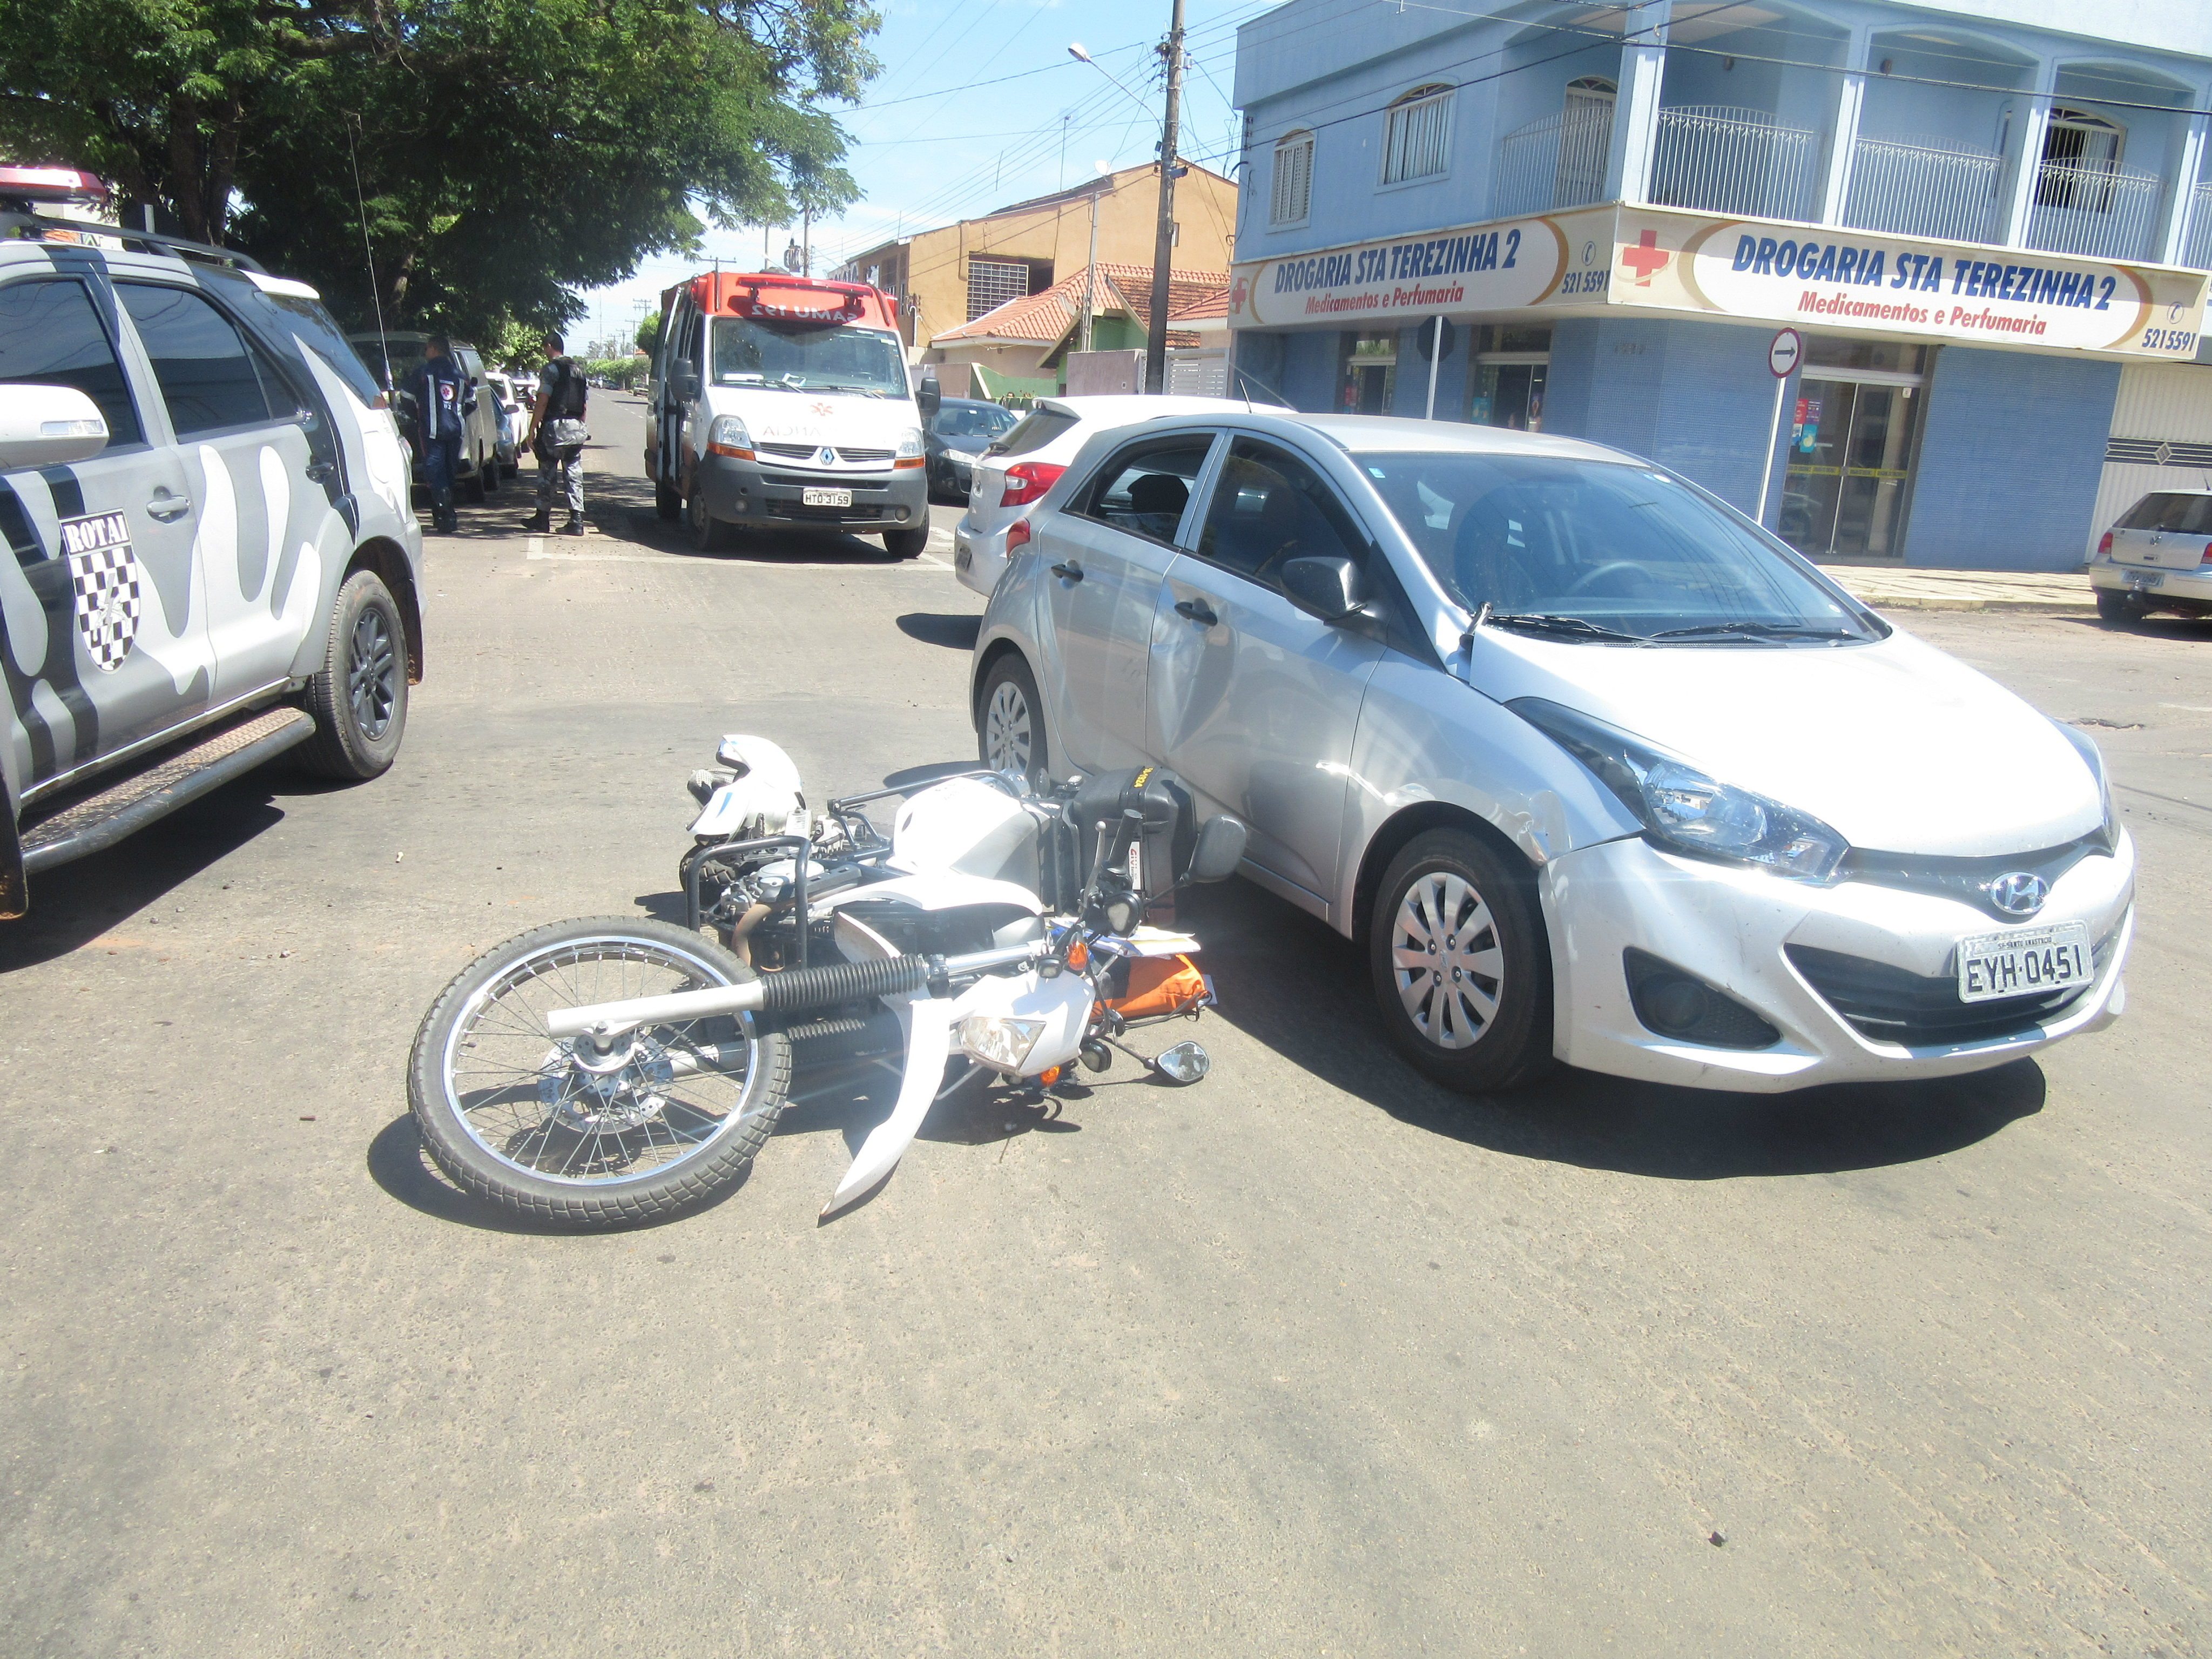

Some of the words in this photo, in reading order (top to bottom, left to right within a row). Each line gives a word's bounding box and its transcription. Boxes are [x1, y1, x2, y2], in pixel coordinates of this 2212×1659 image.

[1274, 254, 1352, 294] DROGARIA
[1354, 248, 1387, 285] STA
[1390, 232, 1498, 280] TEREZINHA
[1501, 228, 1521, 269] 2
[1731, 234, 1885, 287] DROGARIA
[1890, 252, 1943, 292] STA
[1951, 259, 2095, 309] TEREZINHA
[2093, 276, 2116, 311] 2
[1305, 292, 1379, 314] Medicamentos
[1382, 293, 1390, 308] e
[1392, 280, 1464, 307] Perfumaria
[1561, 272, 1582, 294] 521
[1582, 270, 1609, 293] 5591
[1797, 291, 1928, 323] Medicamentos
[1934, 309, 1945, 325] e
[1949, 306, 2047, 335] Perfumaria
[63, 514, 129, 553] ROTAI
